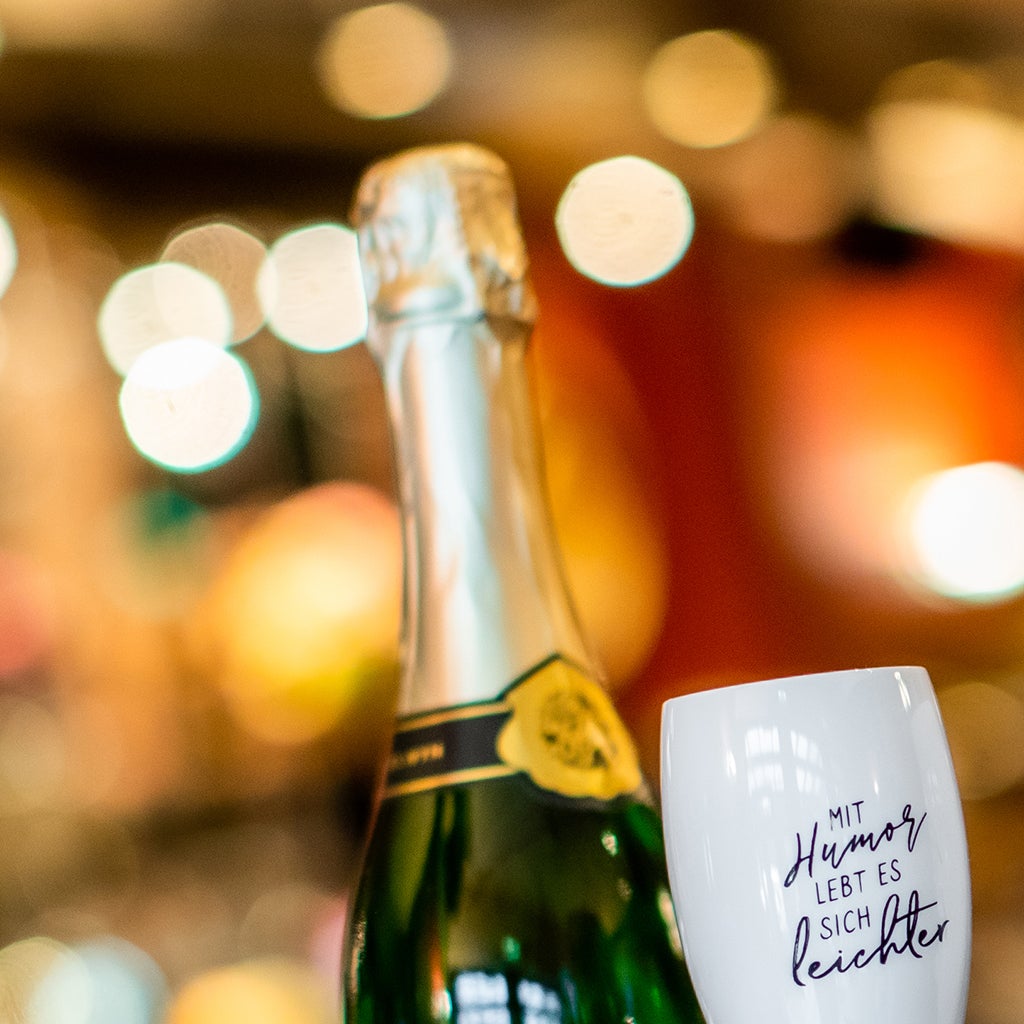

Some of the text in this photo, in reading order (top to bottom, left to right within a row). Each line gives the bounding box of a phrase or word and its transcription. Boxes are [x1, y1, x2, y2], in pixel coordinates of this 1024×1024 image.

[829, 800, 864, 831] MIT
[784, 804, 927, 888] Humor
[815, 859, 901, 905] LEBT ES
[792, 890, 950, 987] leichter
[819, 905, 871, 940] SICH
